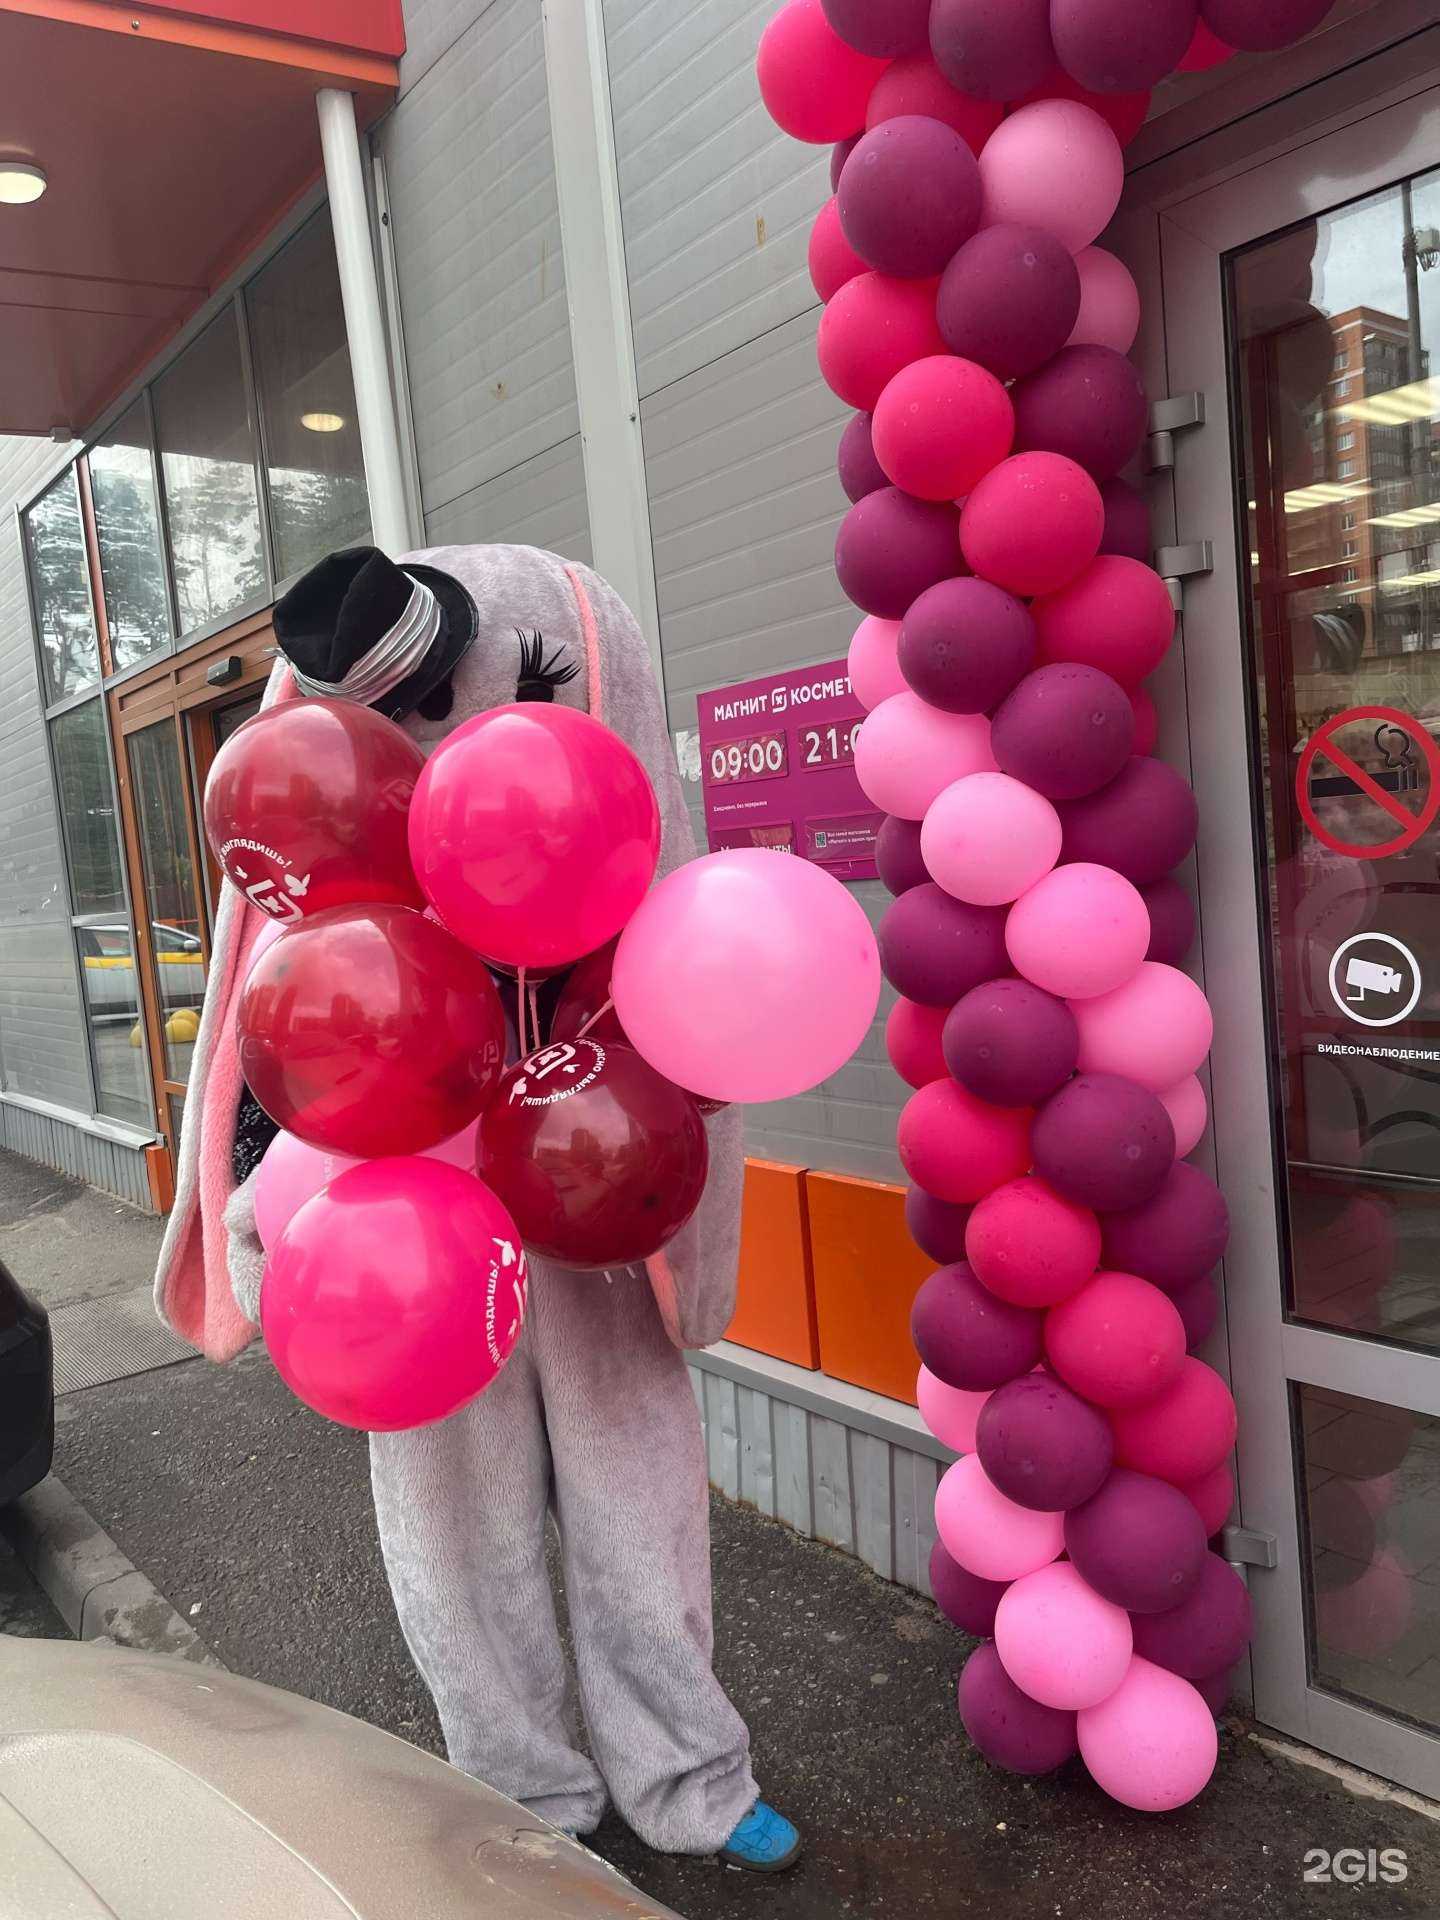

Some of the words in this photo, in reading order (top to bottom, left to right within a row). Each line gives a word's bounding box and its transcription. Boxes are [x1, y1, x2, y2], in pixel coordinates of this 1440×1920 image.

[714, 695, 768, 722] МАГНИТ
[791, 676, 853, 706] КОСМЕТ
[711, 739, 783, 779] 09:00
[805, 723, 863, 764] 21:0
[1317, 1044, 1440, 1061] ВИДЕОНАБЛЮДЕНИЕ
